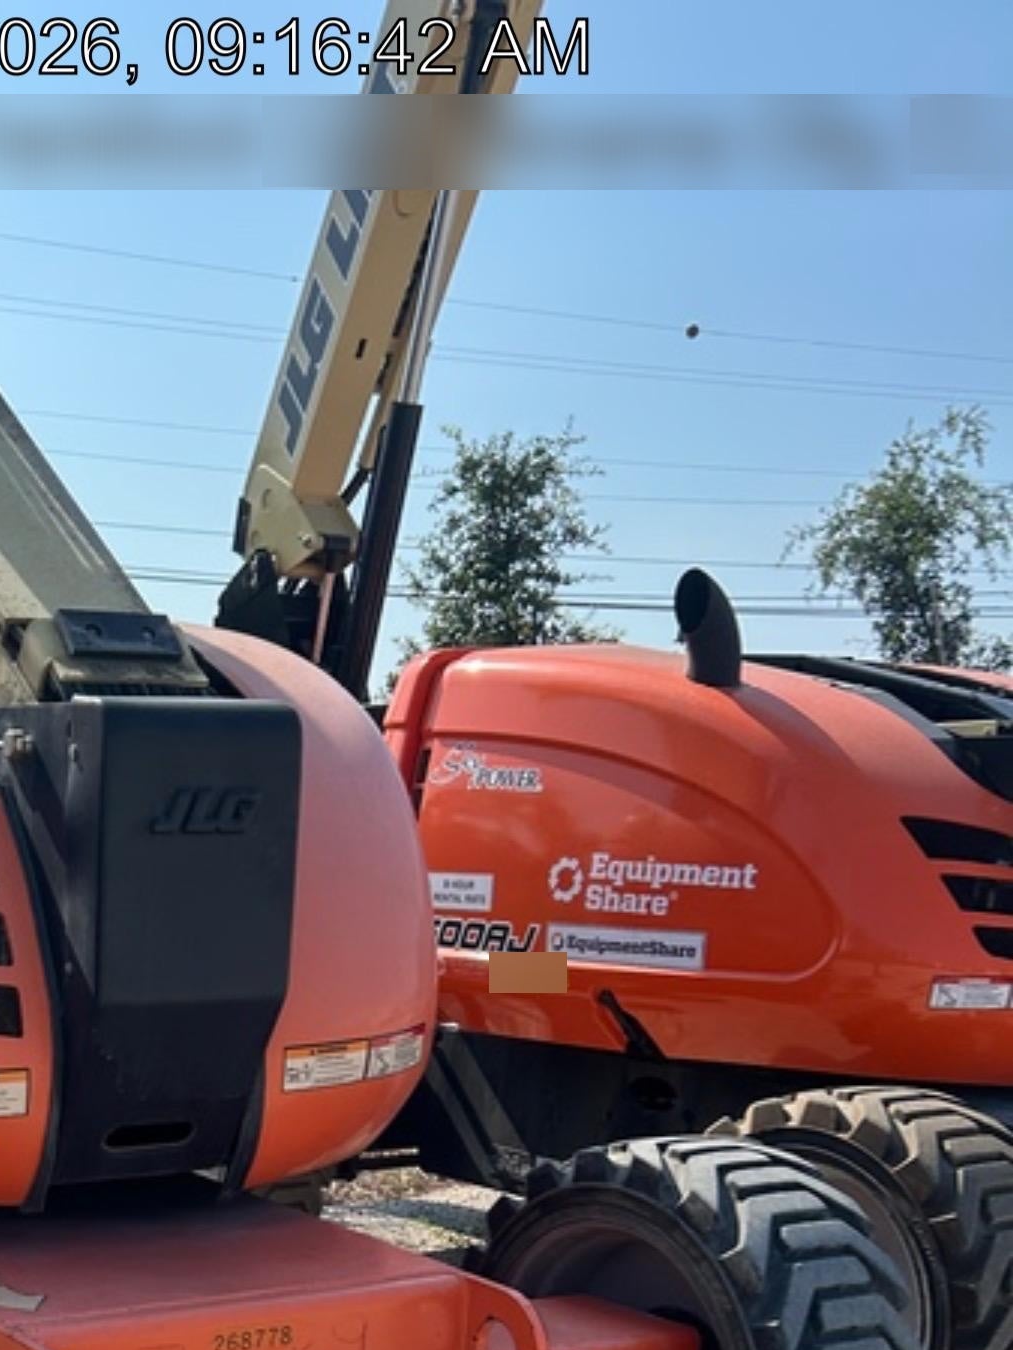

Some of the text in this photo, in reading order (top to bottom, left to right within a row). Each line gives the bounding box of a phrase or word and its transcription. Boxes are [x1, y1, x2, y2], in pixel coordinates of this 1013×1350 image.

[277, 277, 335, 457] JLG
[148, 785, 261, 835] JLG
[589, 852, 759, 889] Equipment
[565, 934, 696, 959] EquipmentShare
